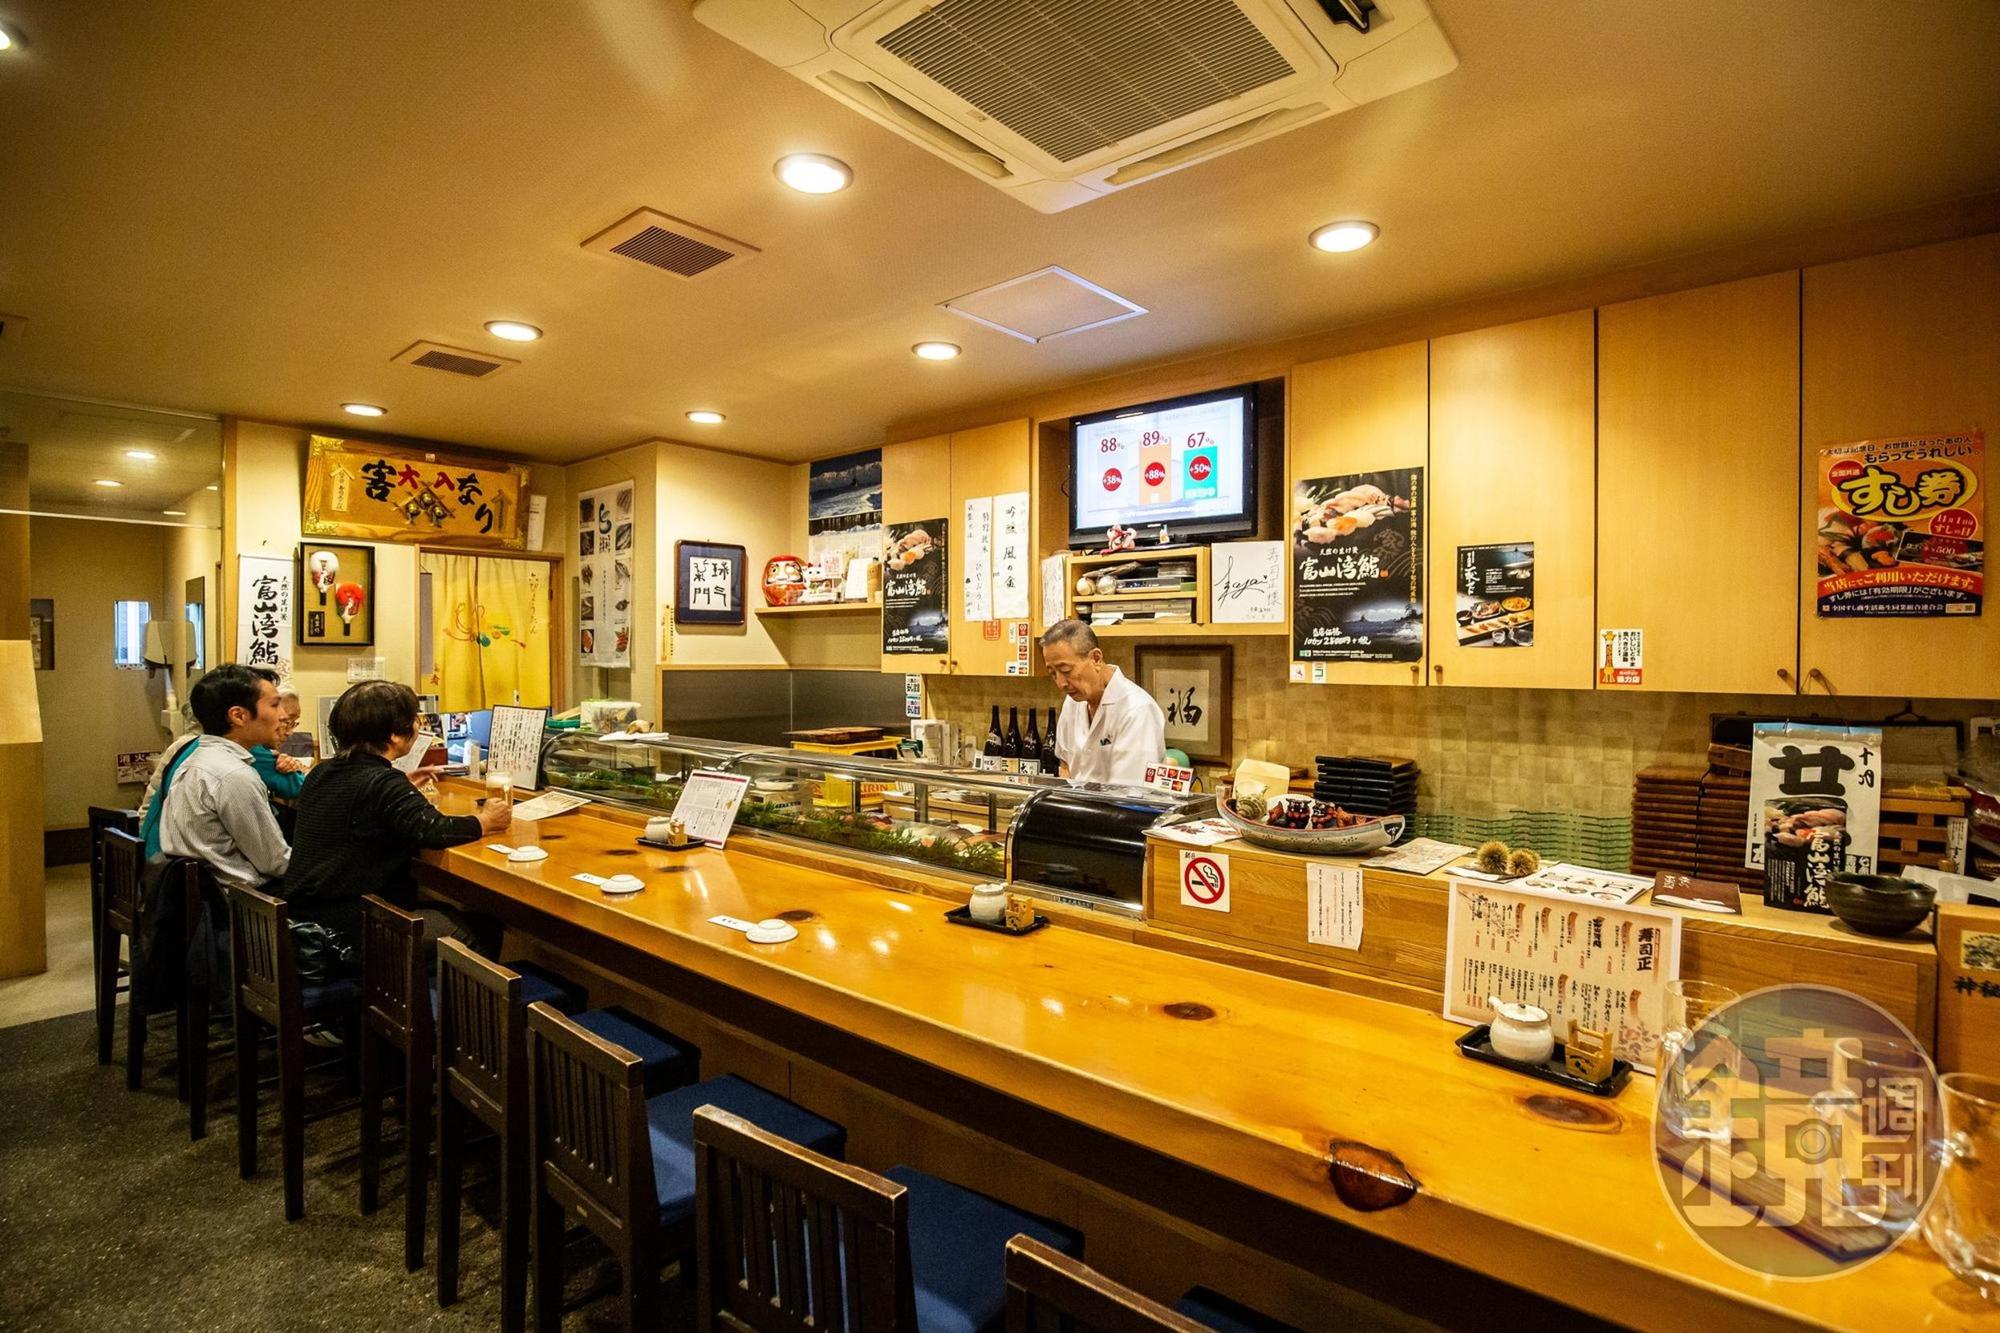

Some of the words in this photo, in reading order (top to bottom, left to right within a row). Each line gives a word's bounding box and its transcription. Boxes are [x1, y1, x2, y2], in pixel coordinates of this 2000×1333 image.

[1100, 438, 1124, 452] 88%
[1142, 430, 1168, 446] 89%
[1188, 432, 1214, 448] 67%
[1864, 446, 1972, 464] もらってうれしい
[1840, 467, 1961, 515] すし券
[1299, 553, 1380, 580] 富山湾鮨
[1824, 570, 1974, 592] 当店にてご利用いただけます。
[249, 574, 279, 665] 富山湾鮨
[1167, 687, 1202, 727] 福
